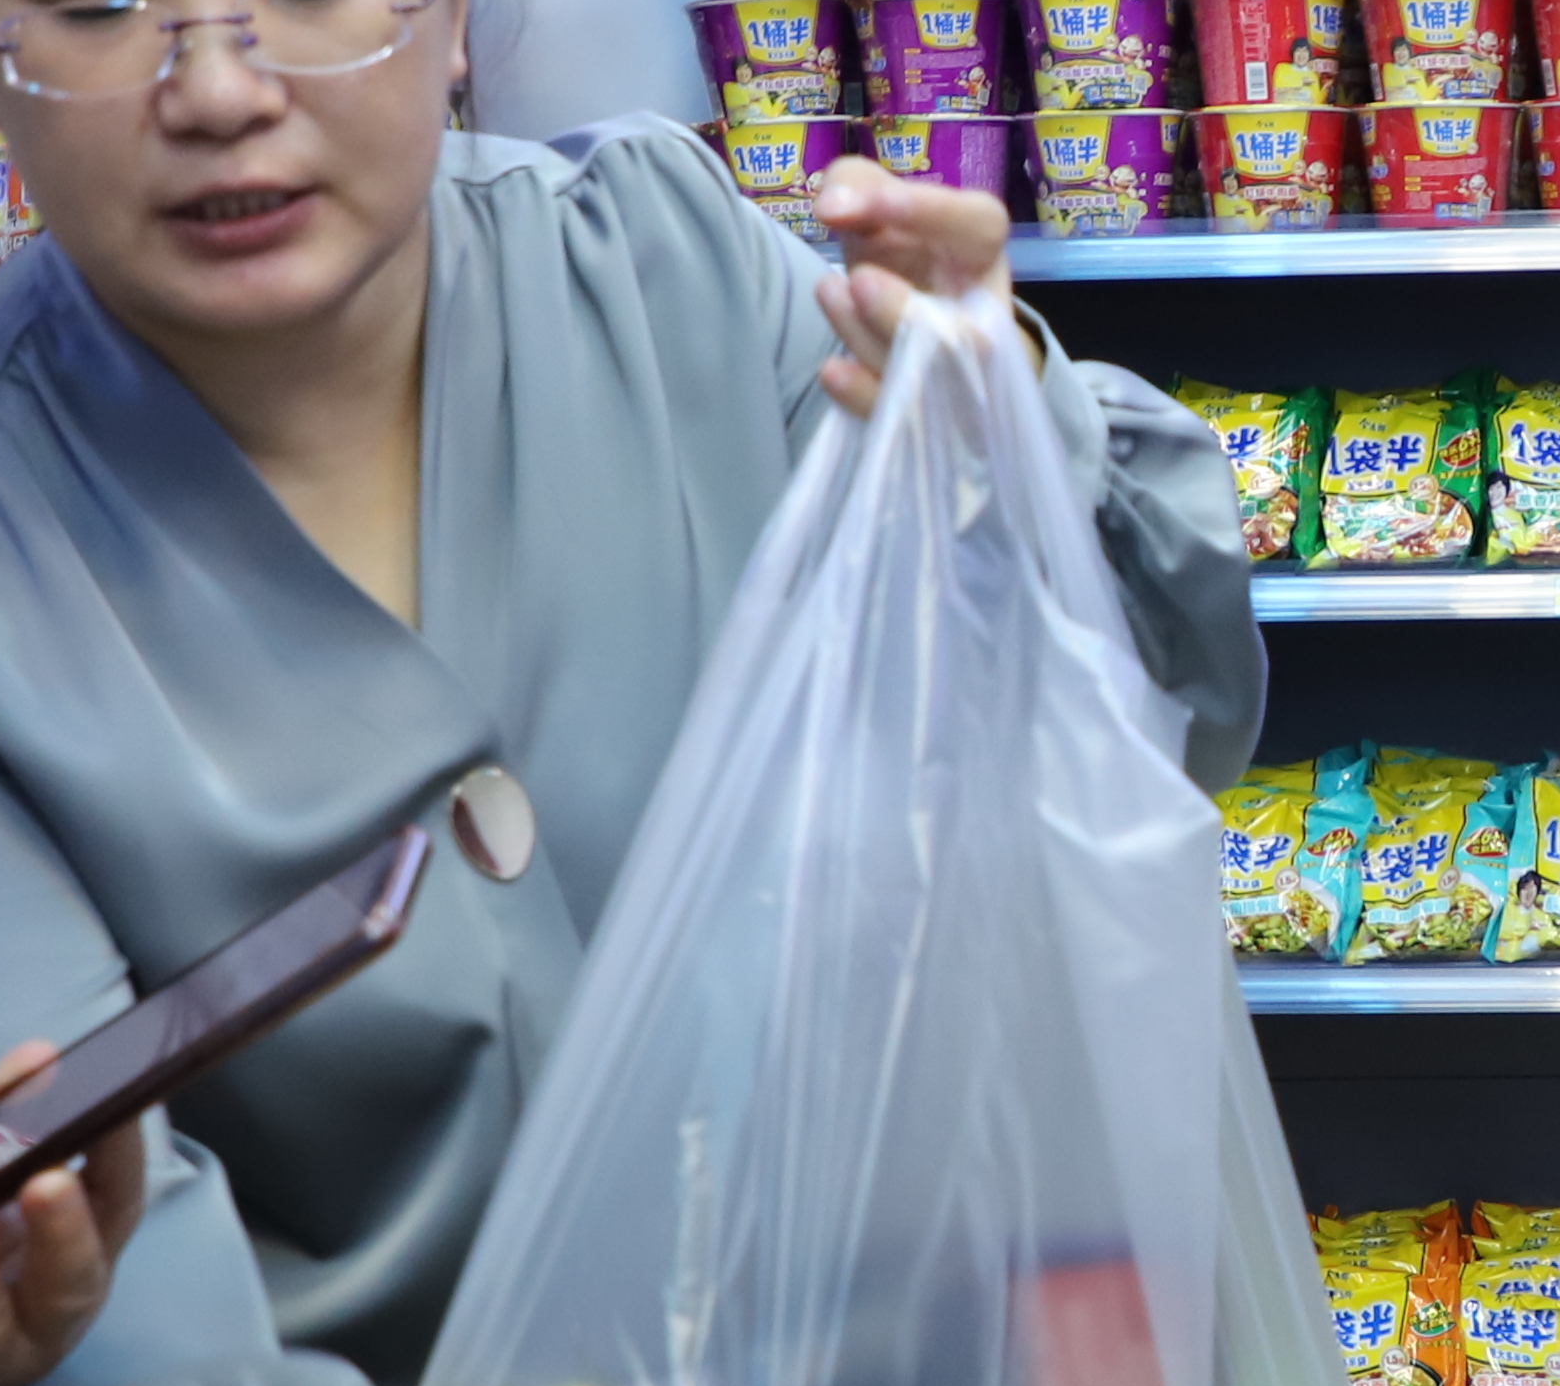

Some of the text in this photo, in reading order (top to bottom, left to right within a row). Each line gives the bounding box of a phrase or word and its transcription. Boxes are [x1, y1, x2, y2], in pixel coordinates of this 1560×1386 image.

[747, 17, 811, 48] 1桶半
[921, 12, 973, 36] 1桶半
[1048, 5, 1110, 36] 1桶半
[1421, 118, 1472, 143] 1桶半
[733, 142, 797, 174] 1桶半
[877, 135, 922, 160] 1桶半
[1042, 136, 1100, 167] 1桶半
[1235, 131, 1299, 162] 1桶半
[1328, 432, 1422, 476] 1袋半
[1462, 1298, 1558, 1350] 1袋半
